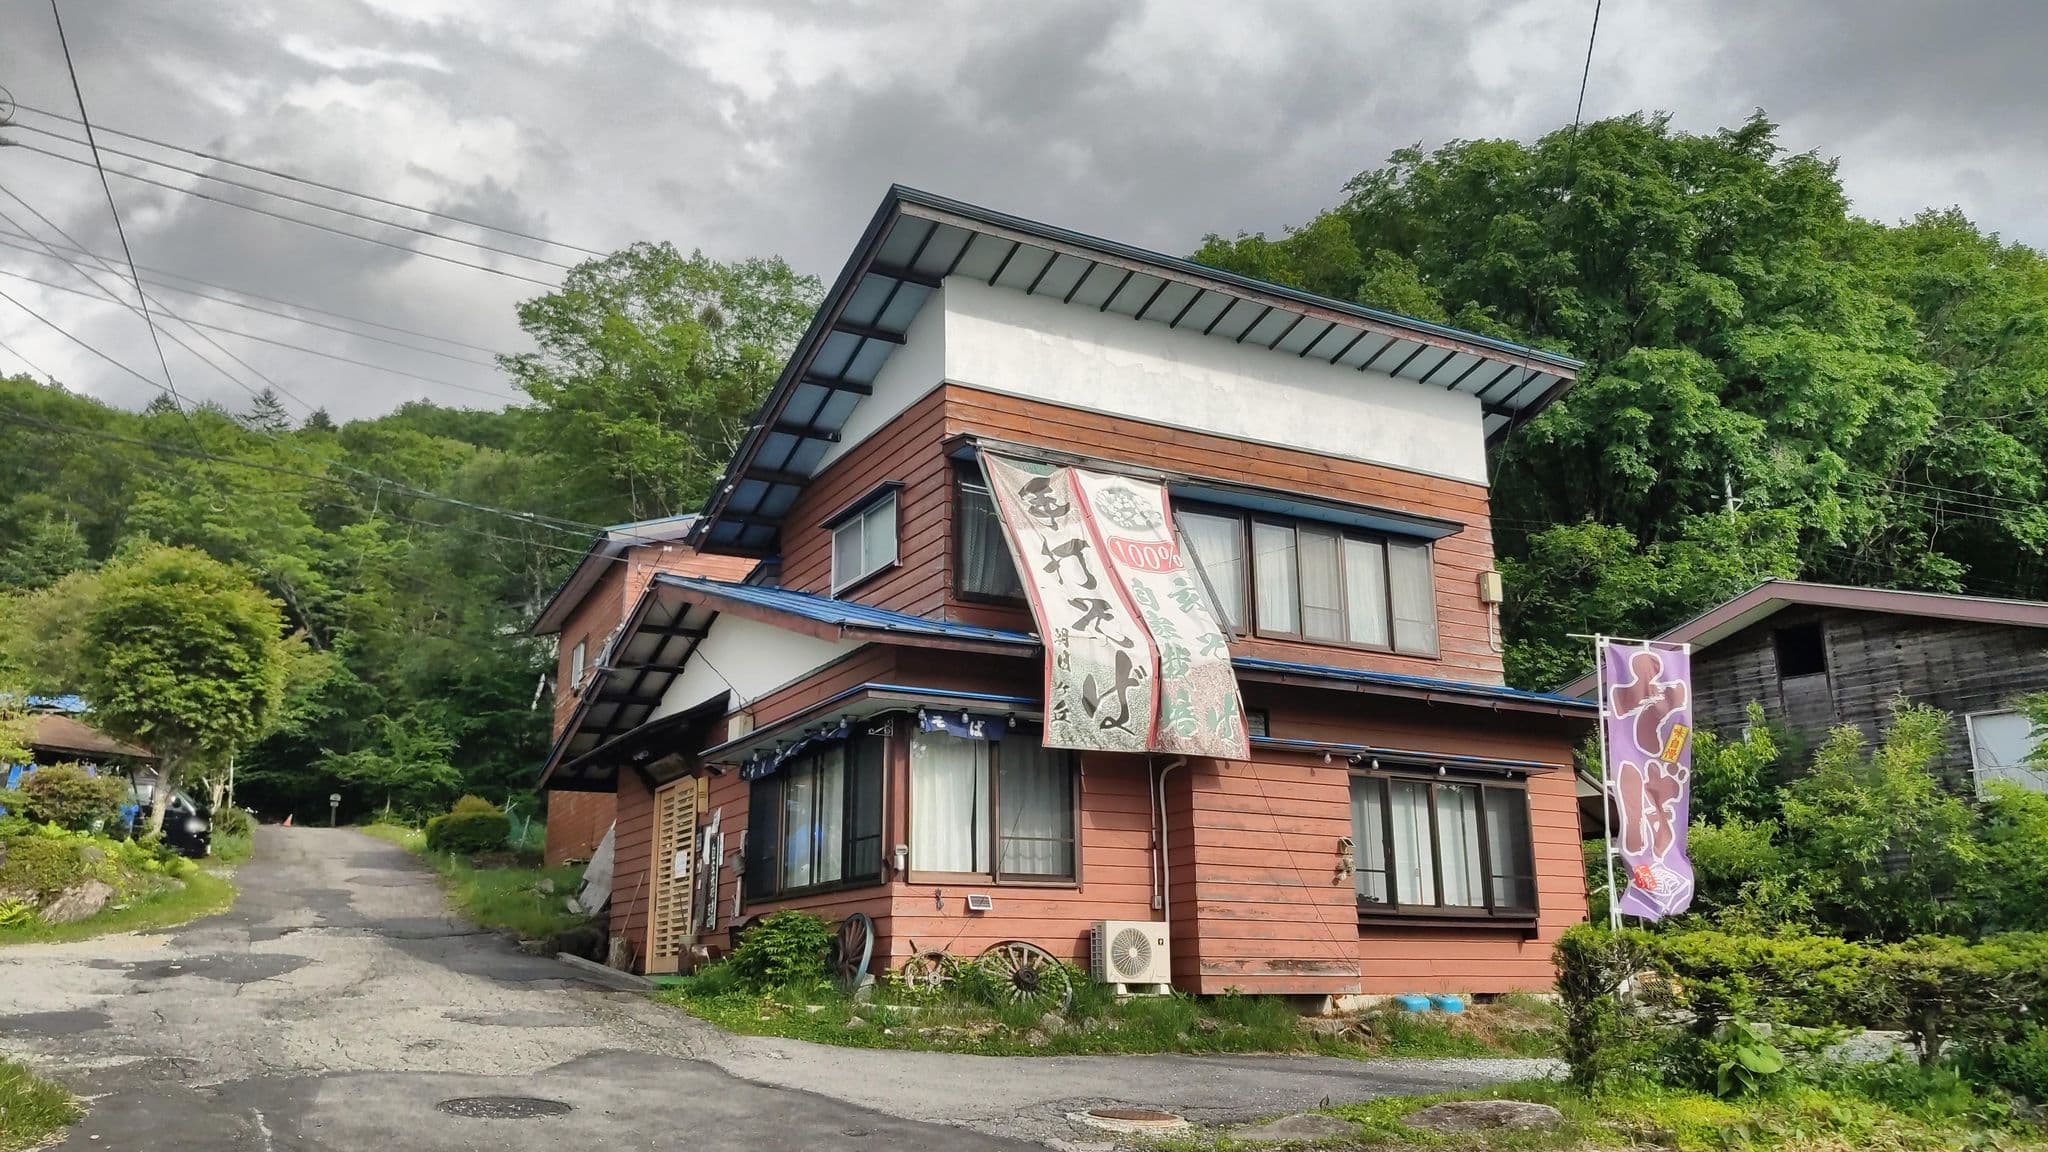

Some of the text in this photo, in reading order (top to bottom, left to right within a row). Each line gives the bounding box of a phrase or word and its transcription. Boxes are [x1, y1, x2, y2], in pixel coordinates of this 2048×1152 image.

[1114, 540, 1185, 569] 100%
[931, 715, 986, 737] そば
[1610, 651, 1690, 861] そば
